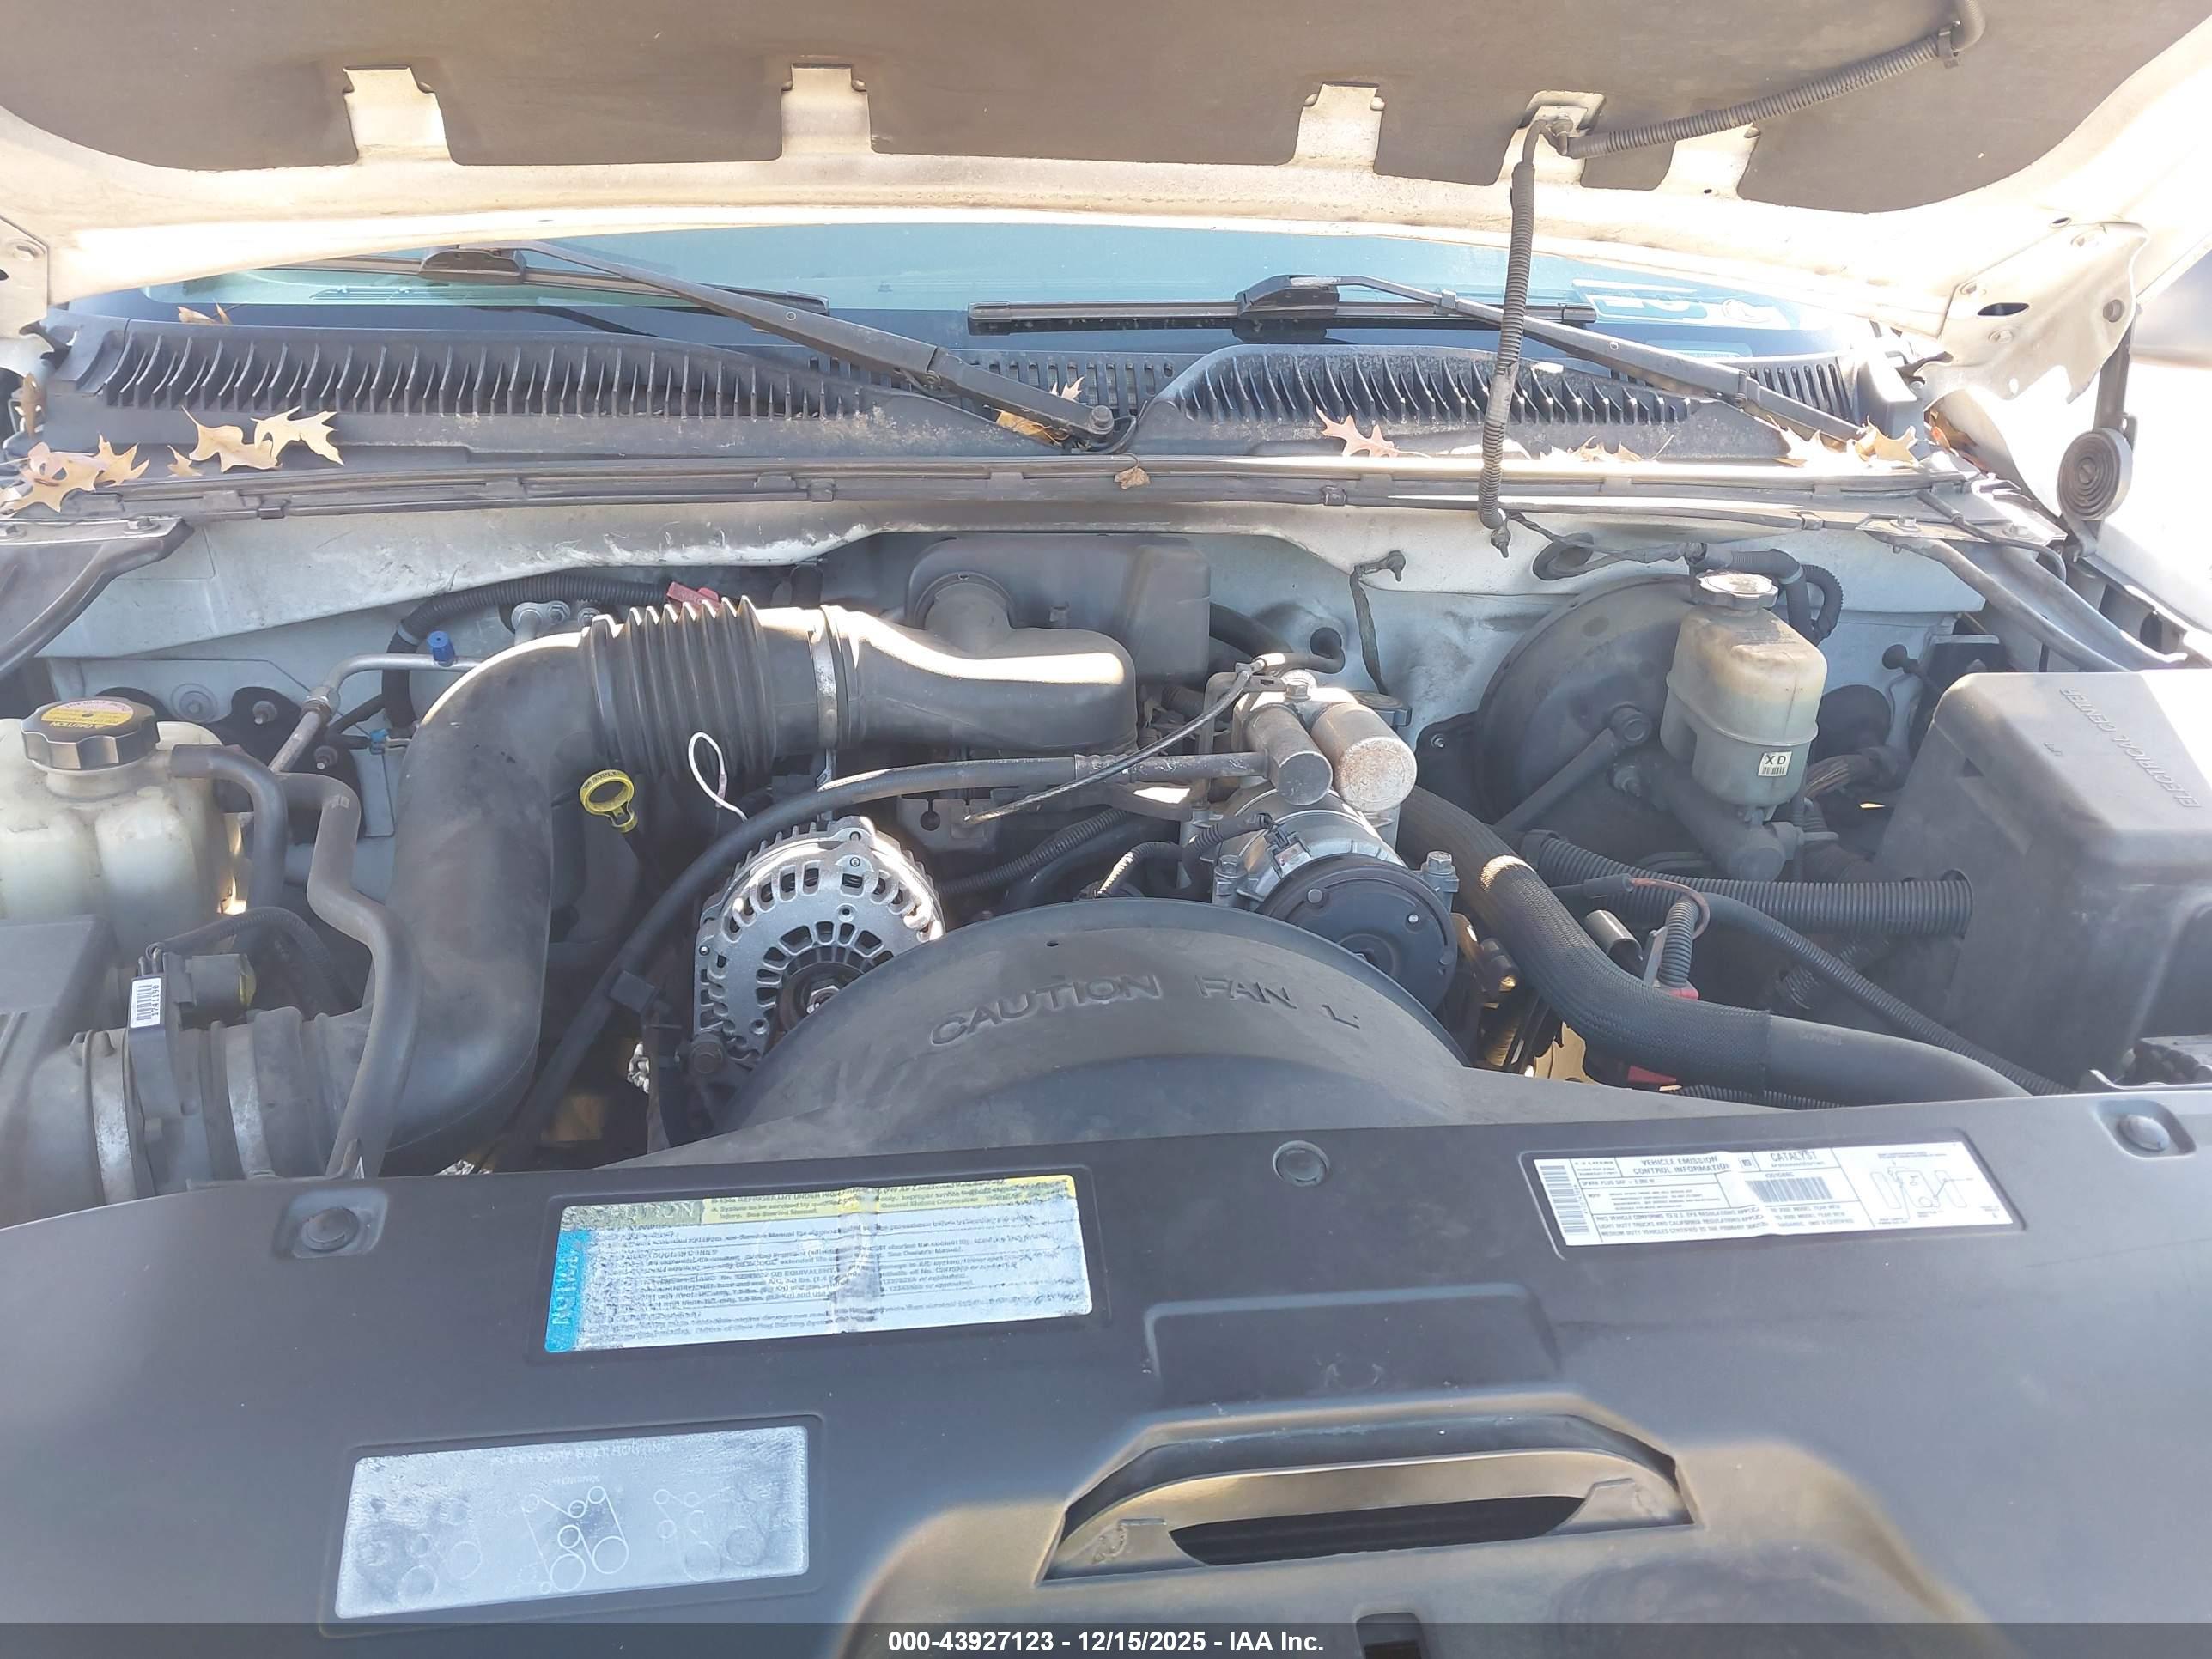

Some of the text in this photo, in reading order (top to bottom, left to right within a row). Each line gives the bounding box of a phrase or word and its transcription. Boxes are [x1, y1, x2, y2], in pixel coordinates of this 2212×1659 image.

[2060, 687, 2202, 807] ELECTRICAL CENTER
[930, 974, 1162, 1046] CAUTION
[1194, 974, 1298, 1011] FAN
[1770, 1150, 1818, 1162] CATALYST
